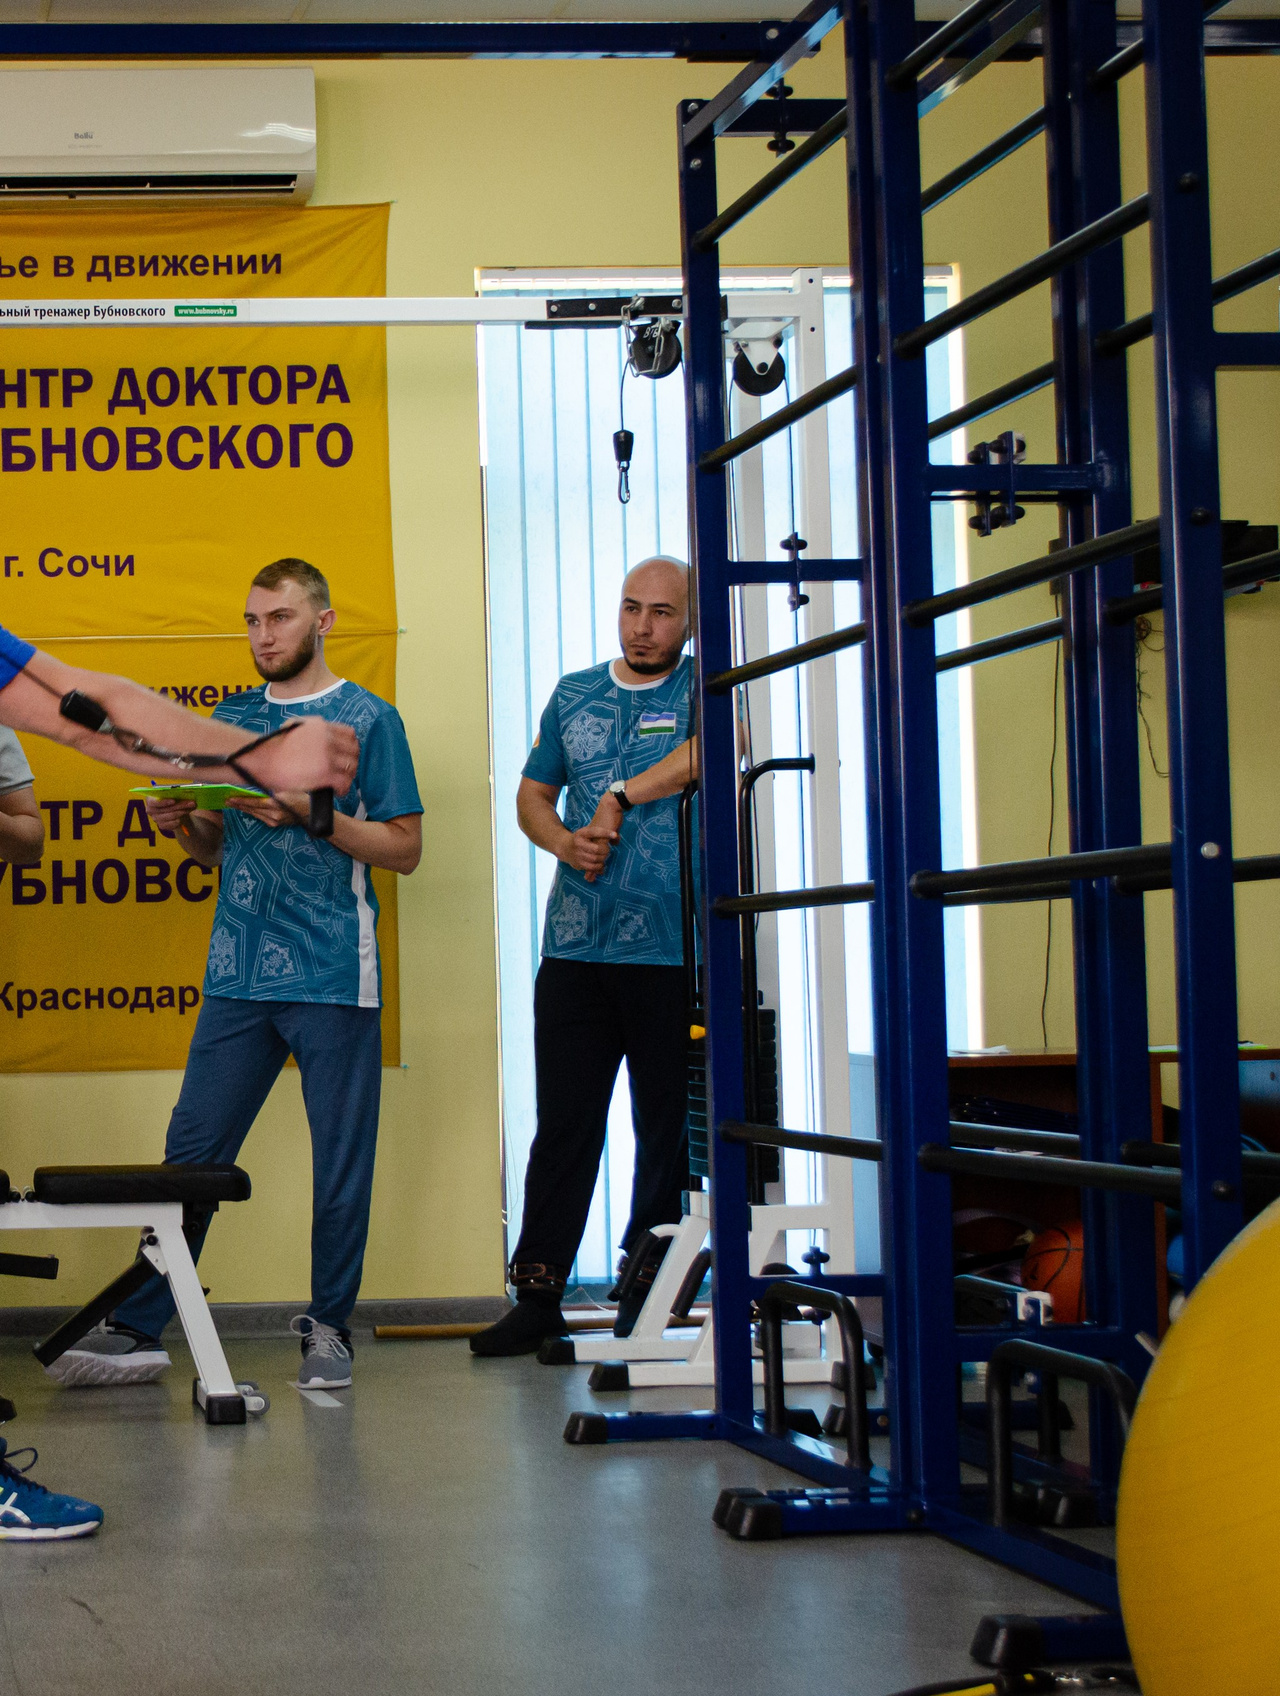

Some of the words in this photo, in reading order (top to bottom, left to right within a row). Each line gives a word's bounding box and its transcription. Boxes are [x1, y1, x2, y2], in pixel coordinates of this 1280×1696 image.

[53, 255, 75, 278] в
[86, 253, 282, 282] движении
[33, 307, 91, 320] тренажер
[93, 305, 166, 319] Бубновского
[107, 364, 351, 415] ДОКТОРА
[4, 555, 24, 578] г.
[38, 547, 135, 578] Сочи
